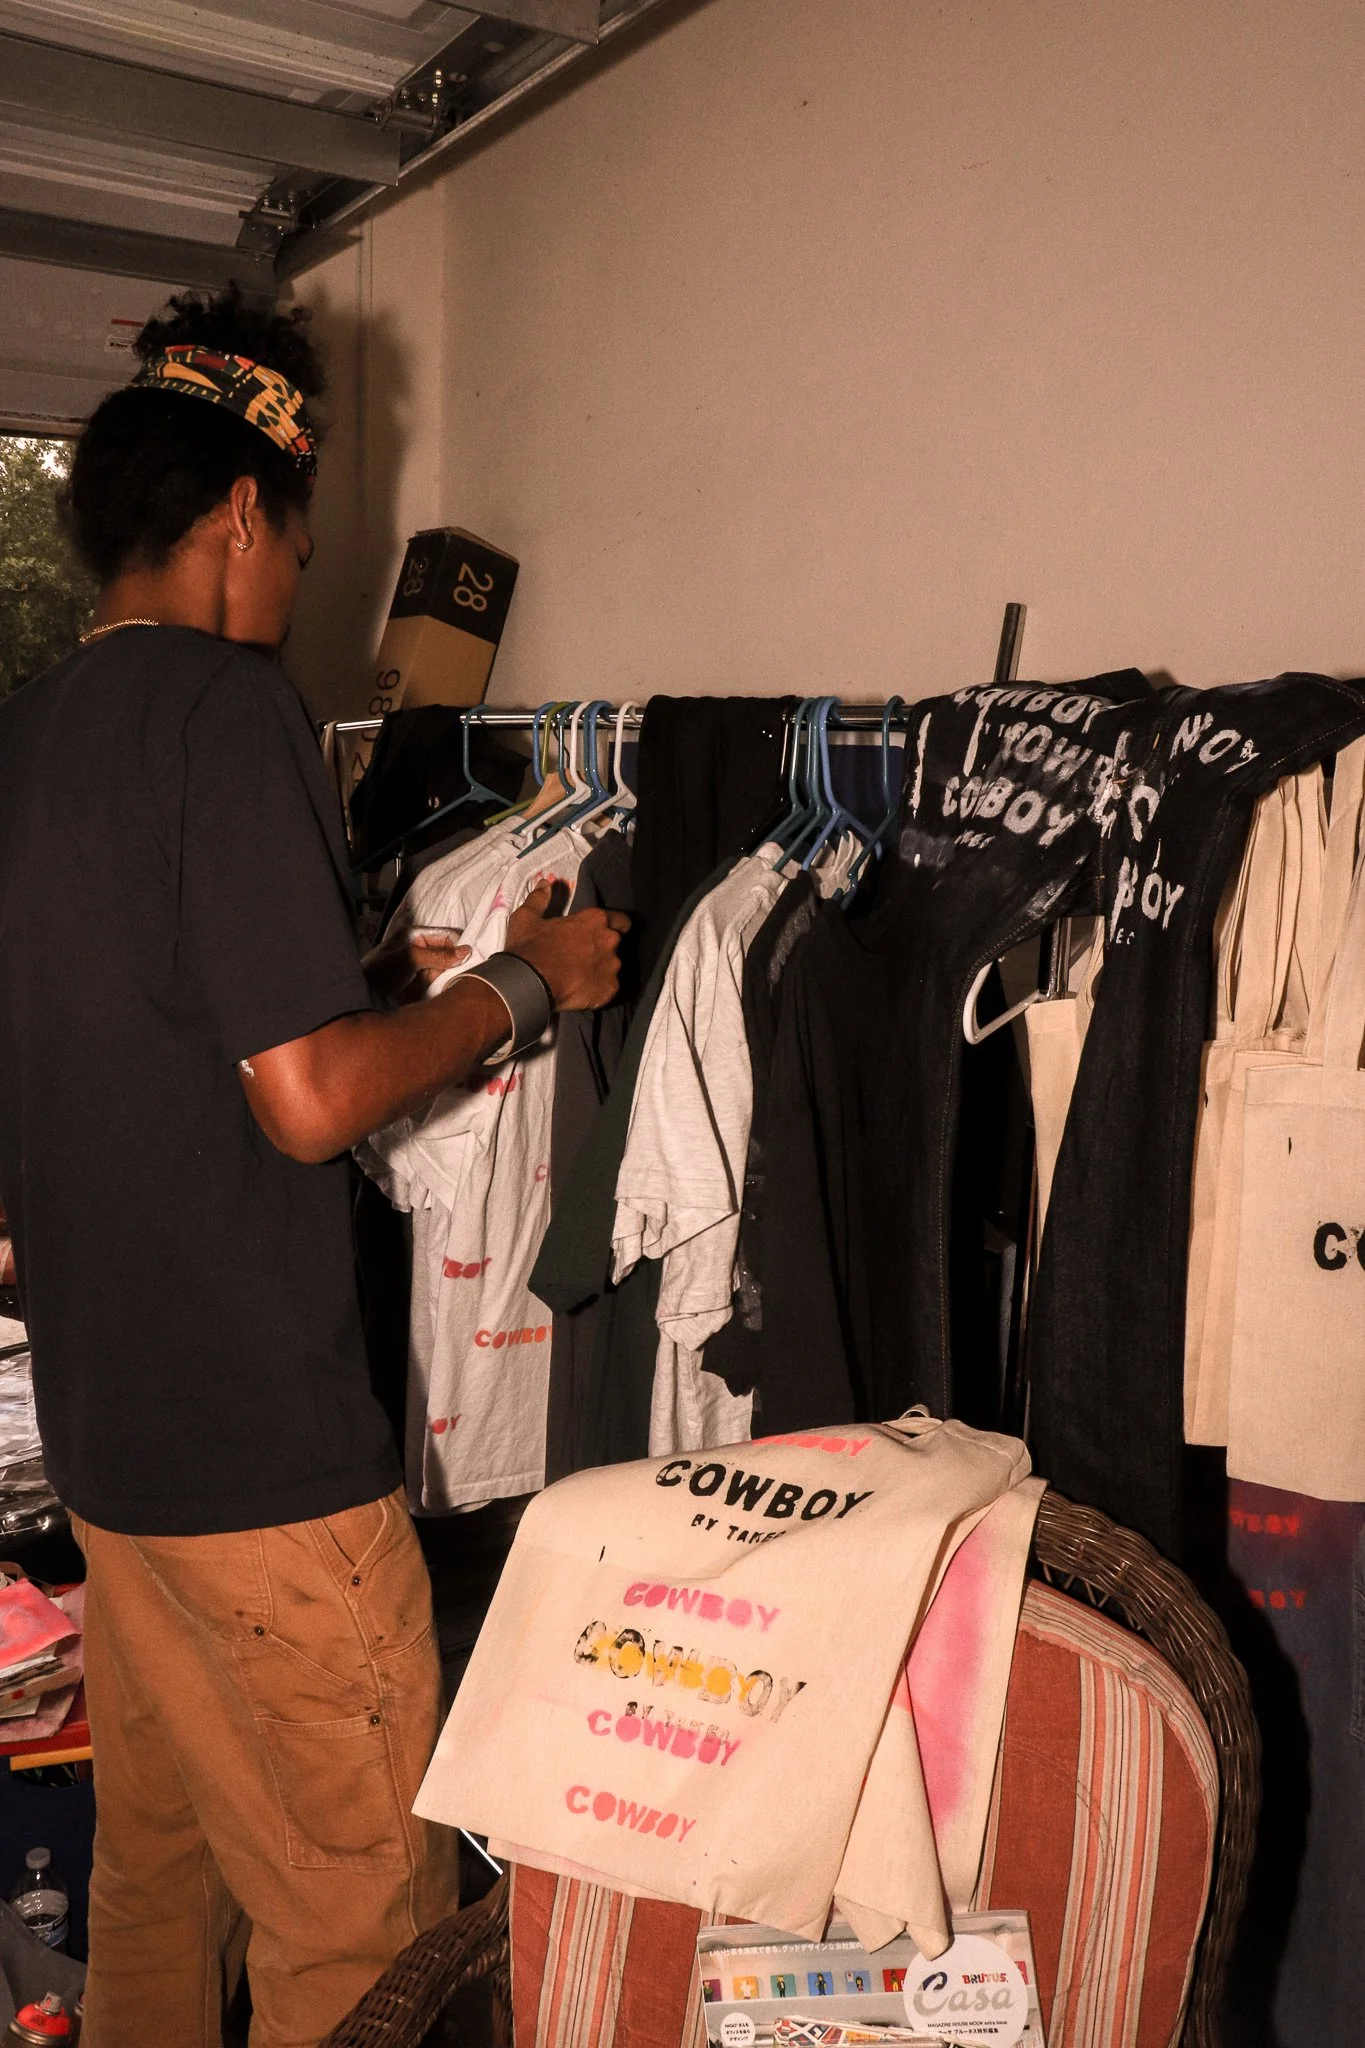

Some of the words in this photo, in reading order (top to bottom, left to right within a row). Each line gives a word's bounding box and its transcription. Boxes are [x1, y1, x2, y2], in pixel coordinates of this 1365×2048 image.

[402, 557, 429, 597] 28
[453, 562, 493, 612] 28
[655, 1459, 876, 1521] COWBOY
[690, 1513, 719, 1531] BY
[623, 1582, 781, 1632] COWBOY
[587, 1709, 743, 1766] COWBOY
[565, 1785, 698, 1843] COWBOY
[913, 1971, 1016, 2017] Casa
